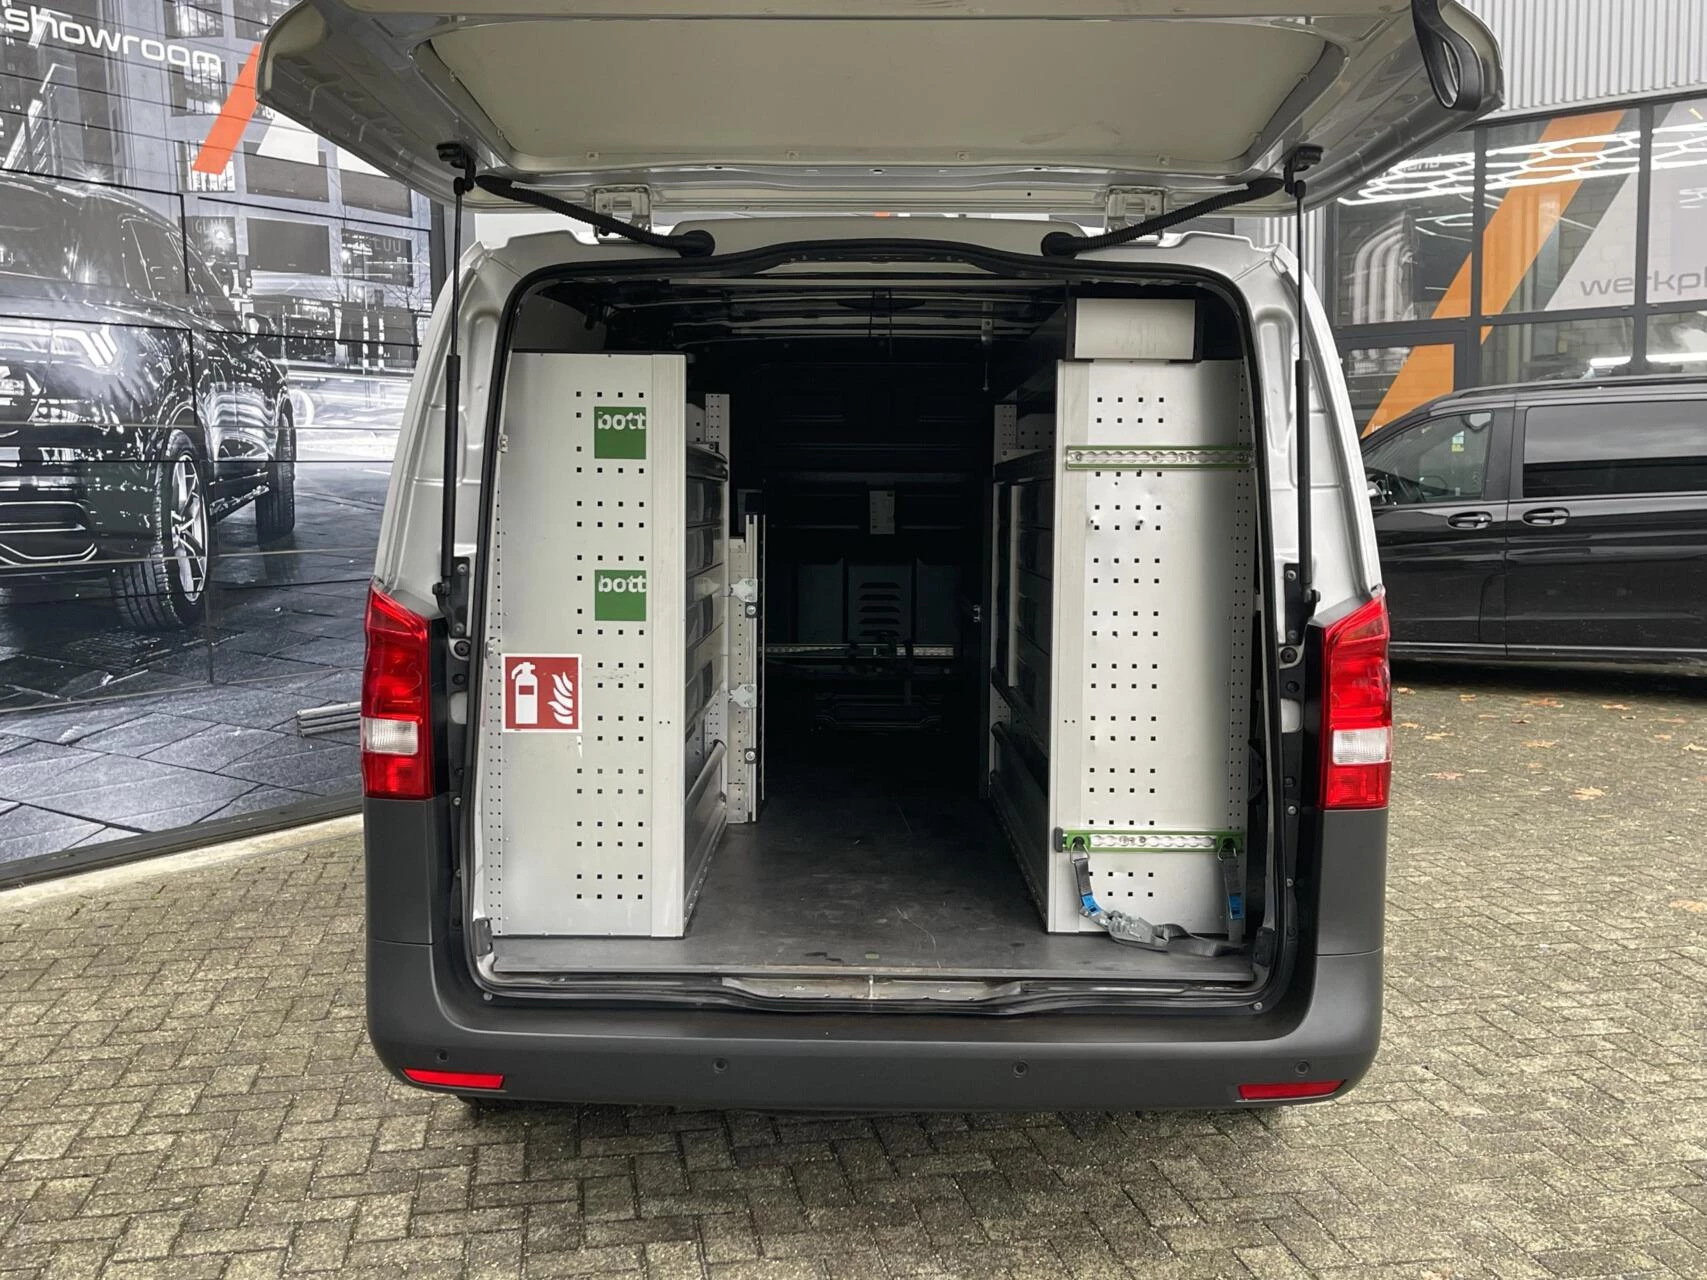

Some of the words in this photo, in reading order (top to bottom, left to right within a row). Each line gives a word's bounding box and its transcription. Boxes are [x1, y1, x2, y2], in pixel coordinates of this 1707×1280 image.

[5, 5, 221, 78] showroom
[1579, 266, 1707, 296] wekpl
[597, 411, 646, 430] bott
[598, 575, 646, 593] bott
